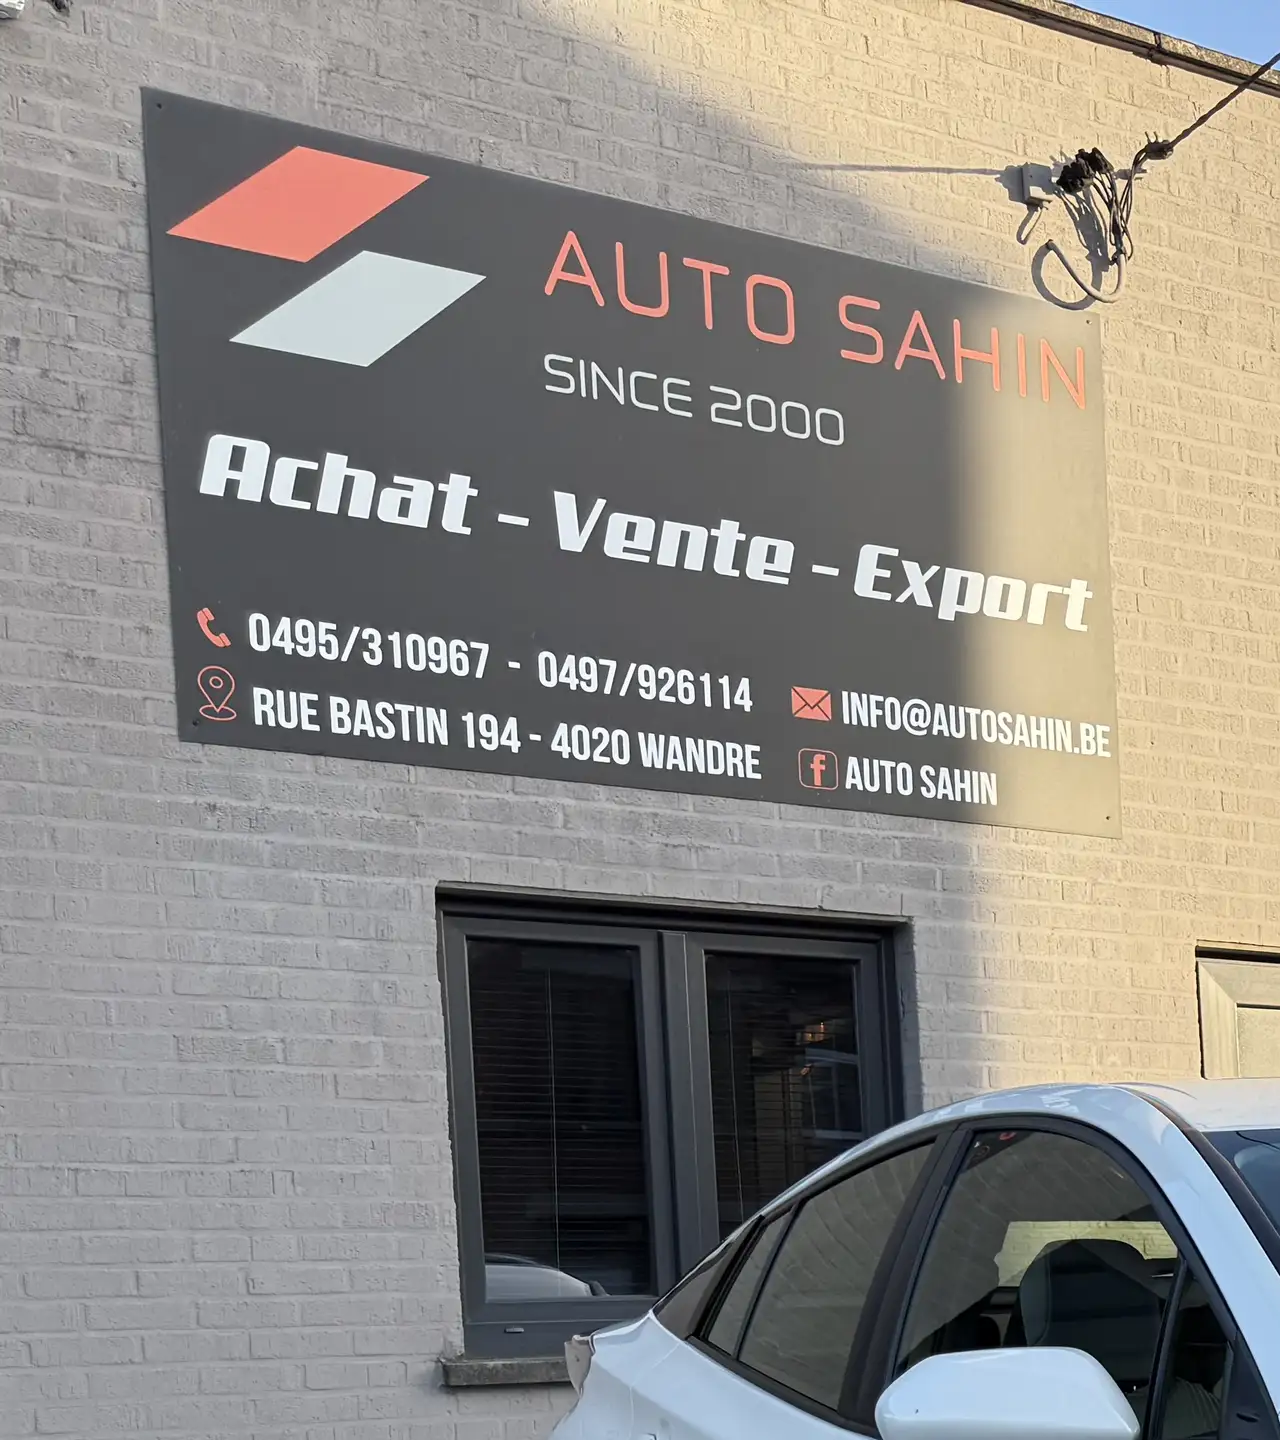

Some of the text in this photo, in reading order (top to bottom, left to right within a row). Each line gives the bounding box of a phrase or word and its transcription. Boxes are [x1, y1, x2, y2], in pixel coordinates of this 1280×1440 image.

[544, 230, 1086, 410] AUTO SAHIN
[544, 353, 845, 446] SINCE 2000
[199, 433, 479, 535] Achat
[553, 490, 795, 585] Vente
[853, 543, 1093, 631] Export
[248, 612, 489, 679] 0495/310967
[538, 650, 753, 713] 0497/926114
[252, 687, 321, 732] RUE
[330, 697, 449, 746] BASTIN
[461, 711, 521, 754] 194
[551, 723, 631, 766] 4020
[638, 731, 762, 781] WANDRE
[841, 690, 1112, 758] INFO@AUTOSAHIN.BE
[845, 756, 999, 806] AUTO SAHIN
